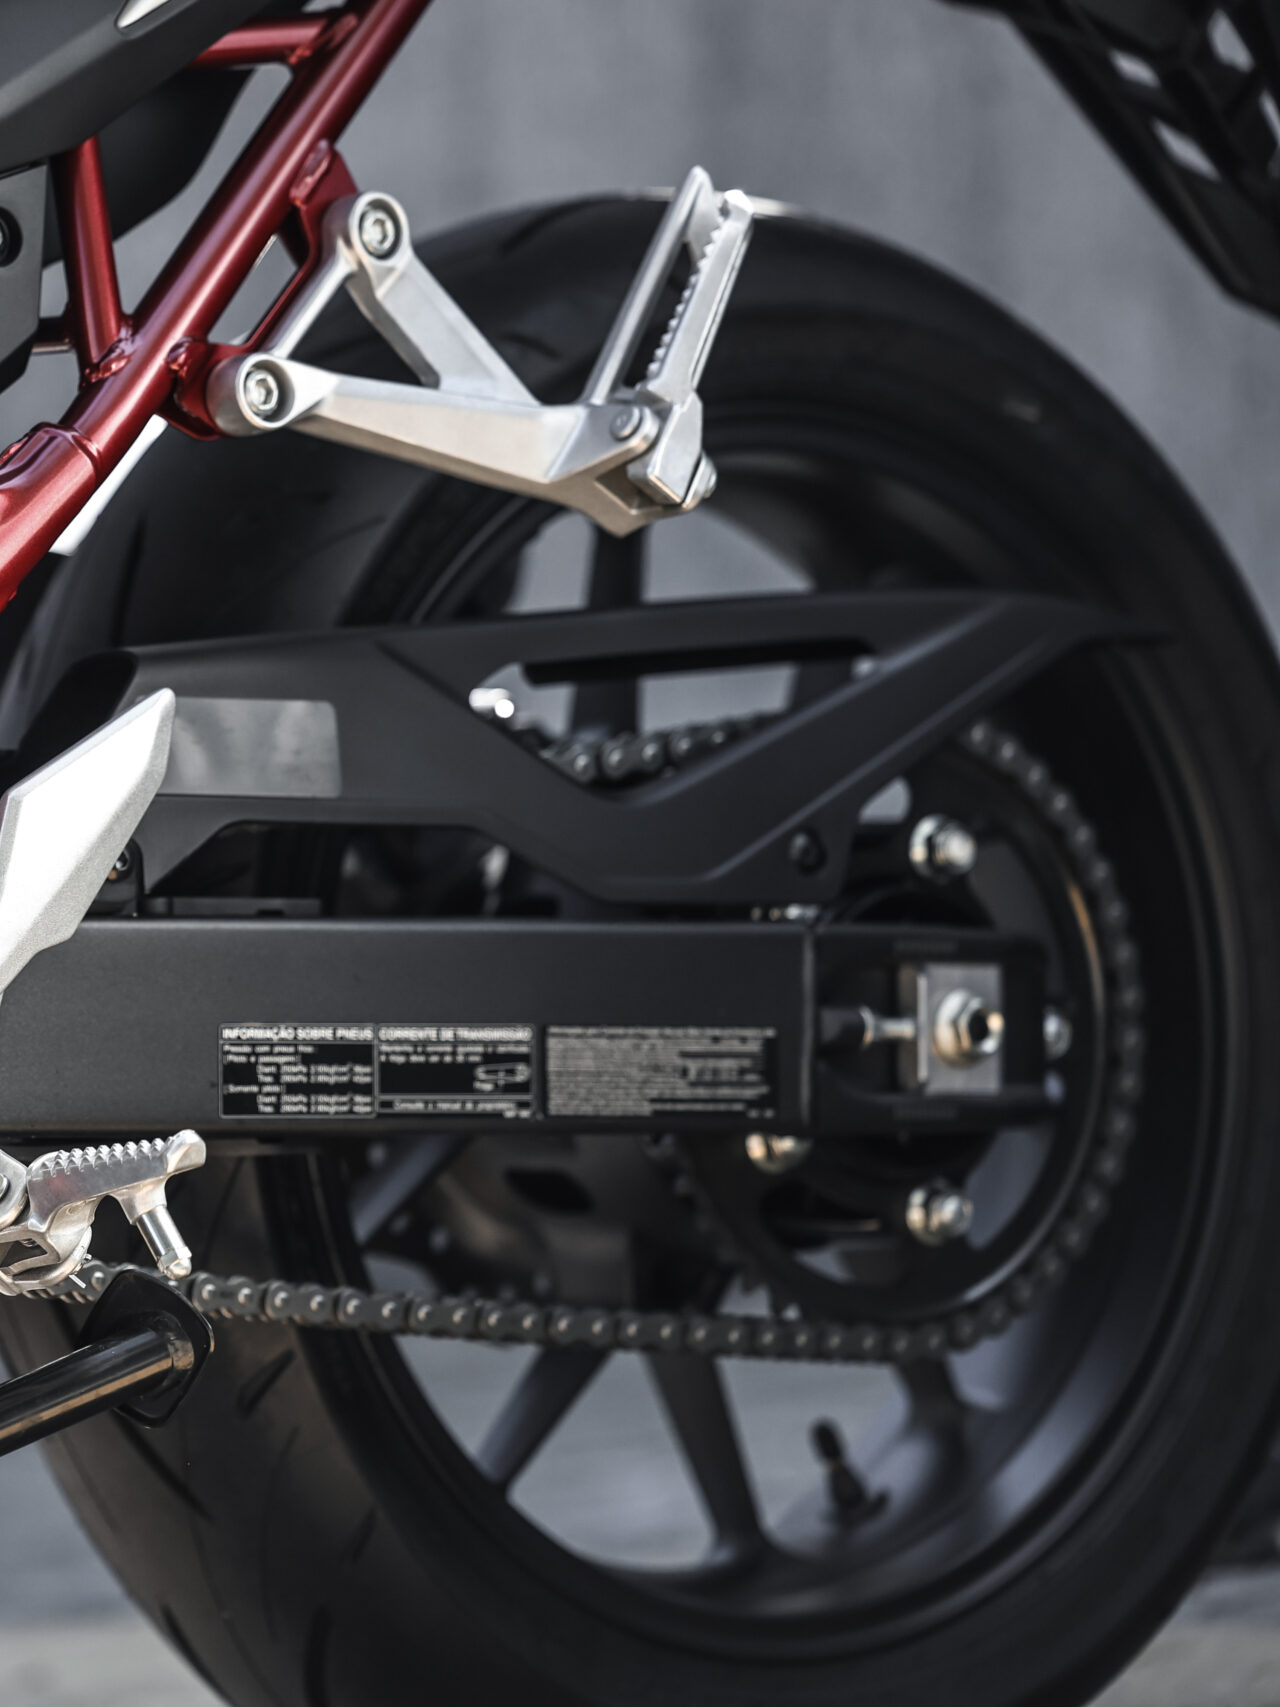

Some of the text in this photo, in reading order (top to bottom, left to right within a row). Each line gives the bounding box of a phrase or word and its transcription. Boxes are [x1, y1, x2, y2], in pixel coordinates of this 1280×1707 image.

[222, 1025, 373, 1041] INFORMAÇÃO SOBRE PNEUS
[378, 1027, 437, 1041] CORRENTE
[439, 1027, 455, 1041] DE
